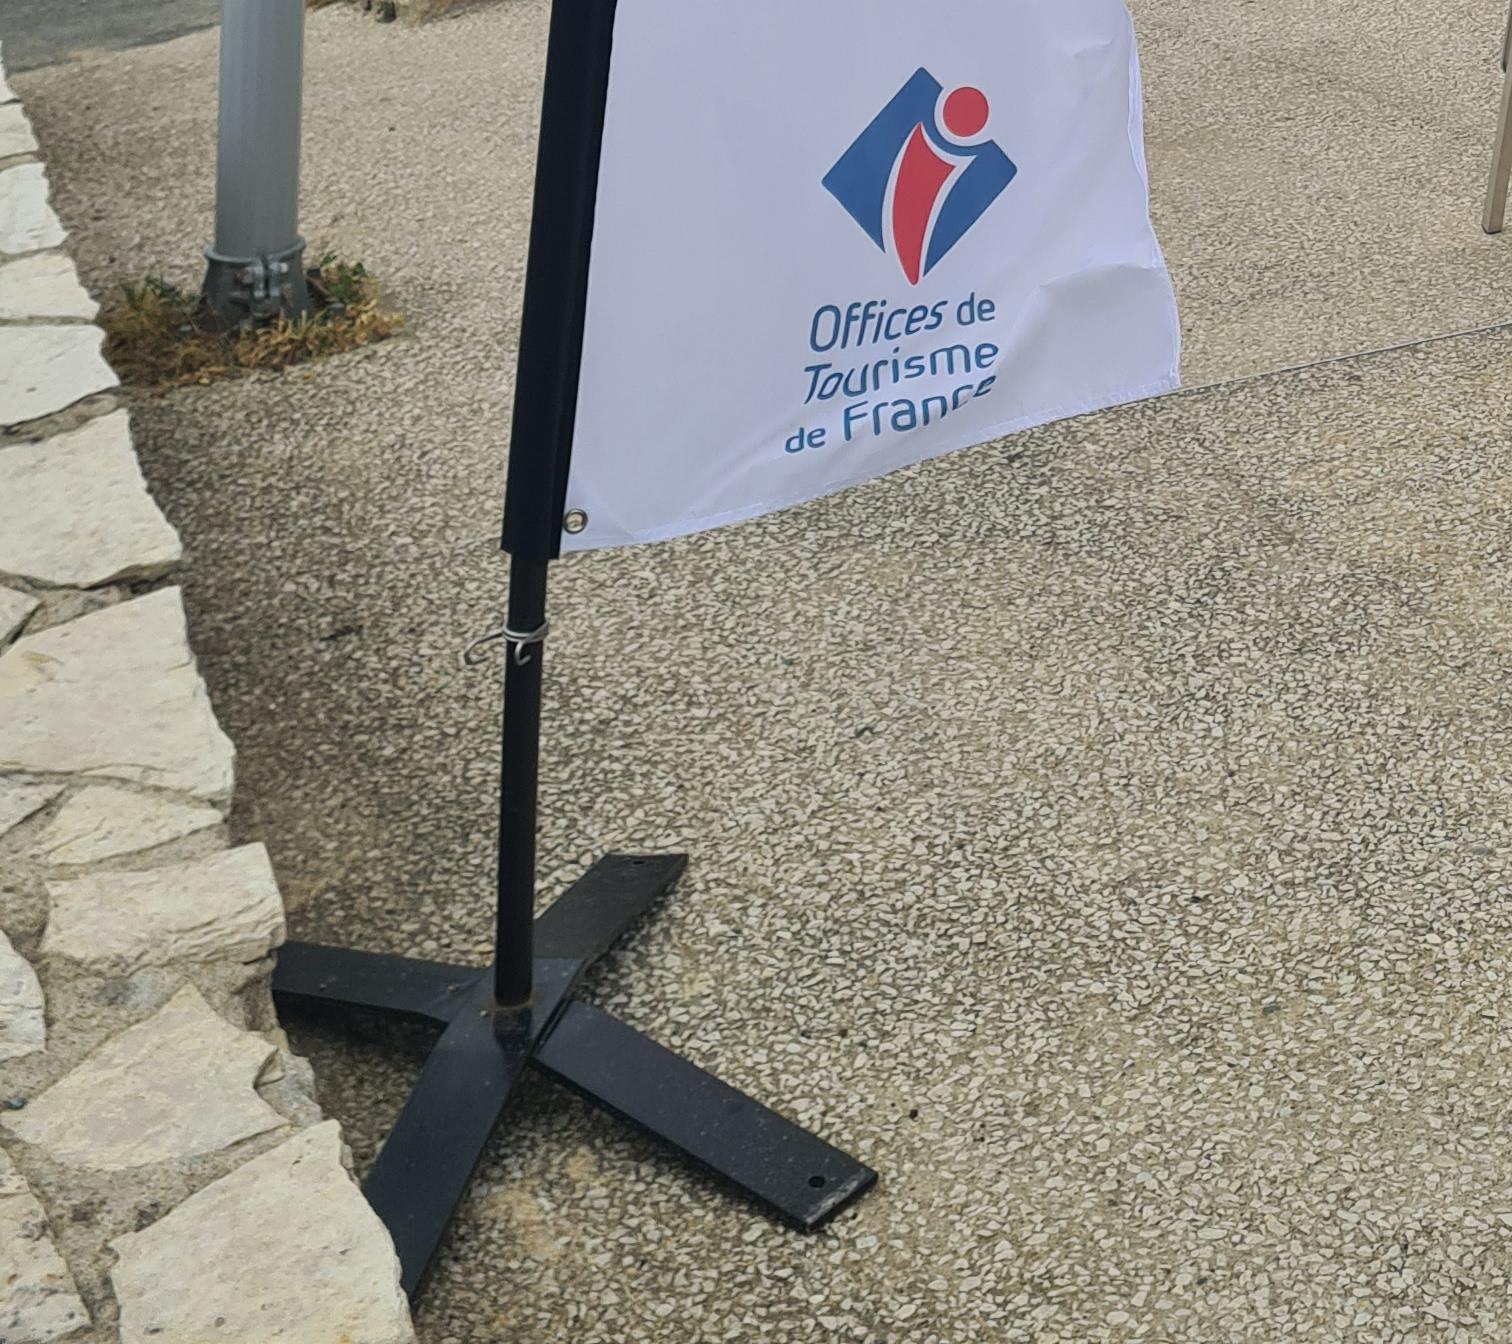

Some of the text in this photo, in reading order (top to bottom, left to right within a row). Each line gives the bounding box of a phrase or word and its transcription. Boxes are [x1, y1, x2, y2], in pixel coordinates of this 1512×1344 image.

[810, 292, 996, 353] Offices de
[803, 342, 999, 404] Tourisme
[784, 426, 826, 454] de
